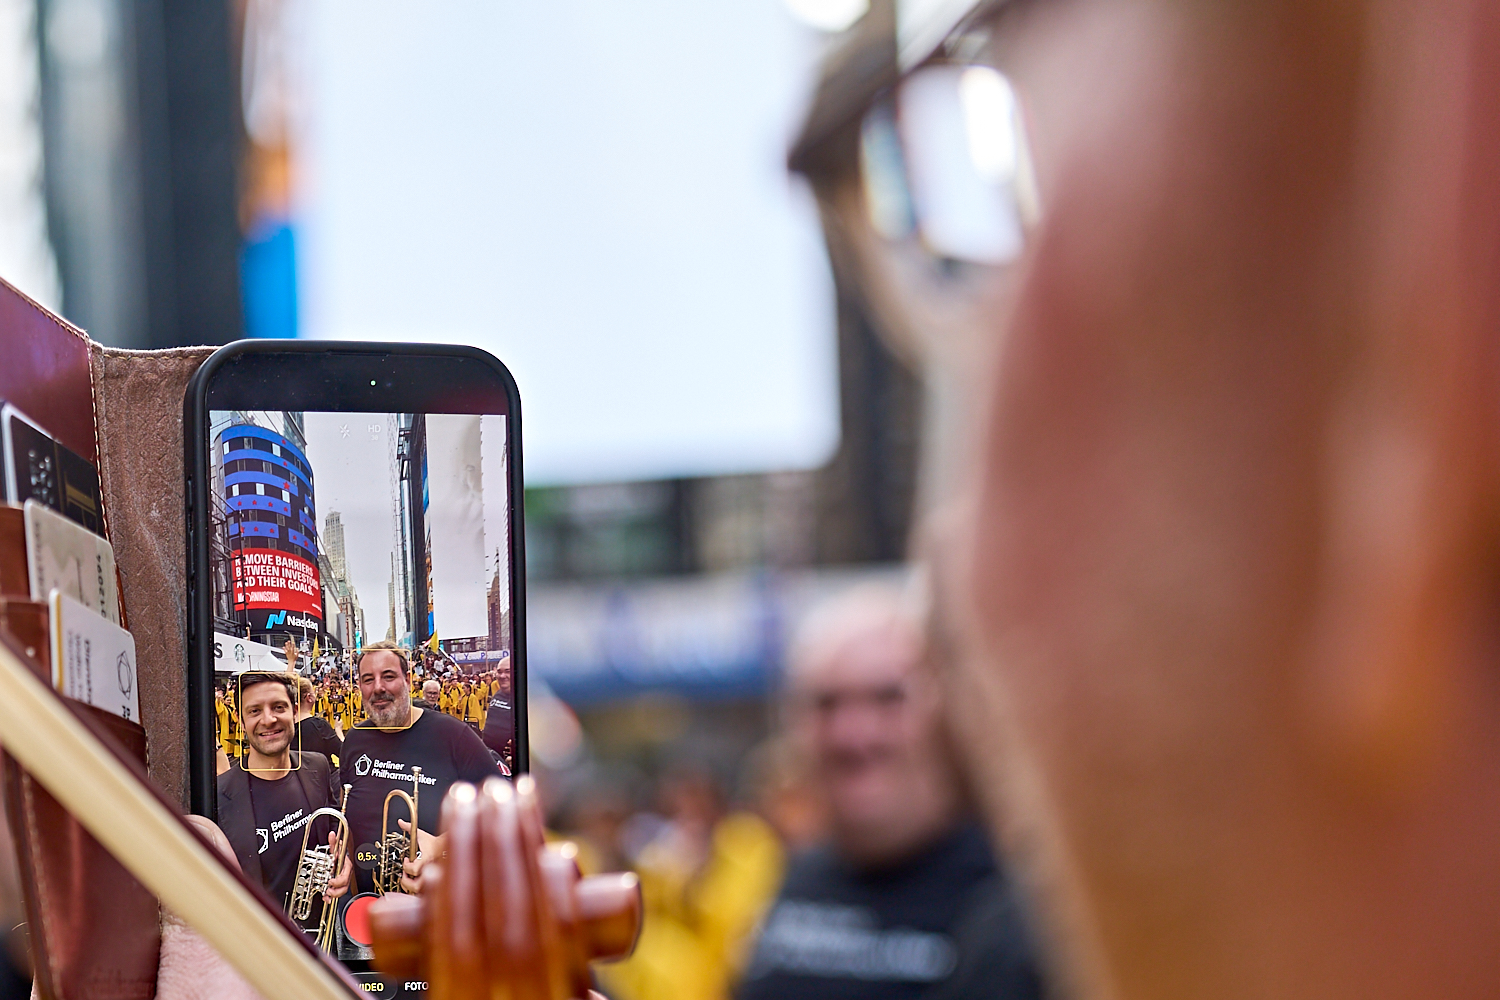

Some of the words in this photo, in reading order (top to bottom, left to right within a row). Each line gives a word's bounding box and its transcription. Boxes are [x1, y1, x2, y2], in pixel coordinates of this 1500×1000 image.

[367, 425, 381, 433] HD
[275, 555, 314, 577] BARRIERS
[257, 576, 287, 589] THEIR
[287, 580, 315, 597] GOALS.
[281, 567, 319, 590] INVESTORS
[286, 615, 319, 632] Nasdaq
[373, 759, 405, 771] Berliner
[270, 808, 303, 832] Berliner
[416, 851, 422, 860] 2
[404, 981, 429, 991] FOTO
